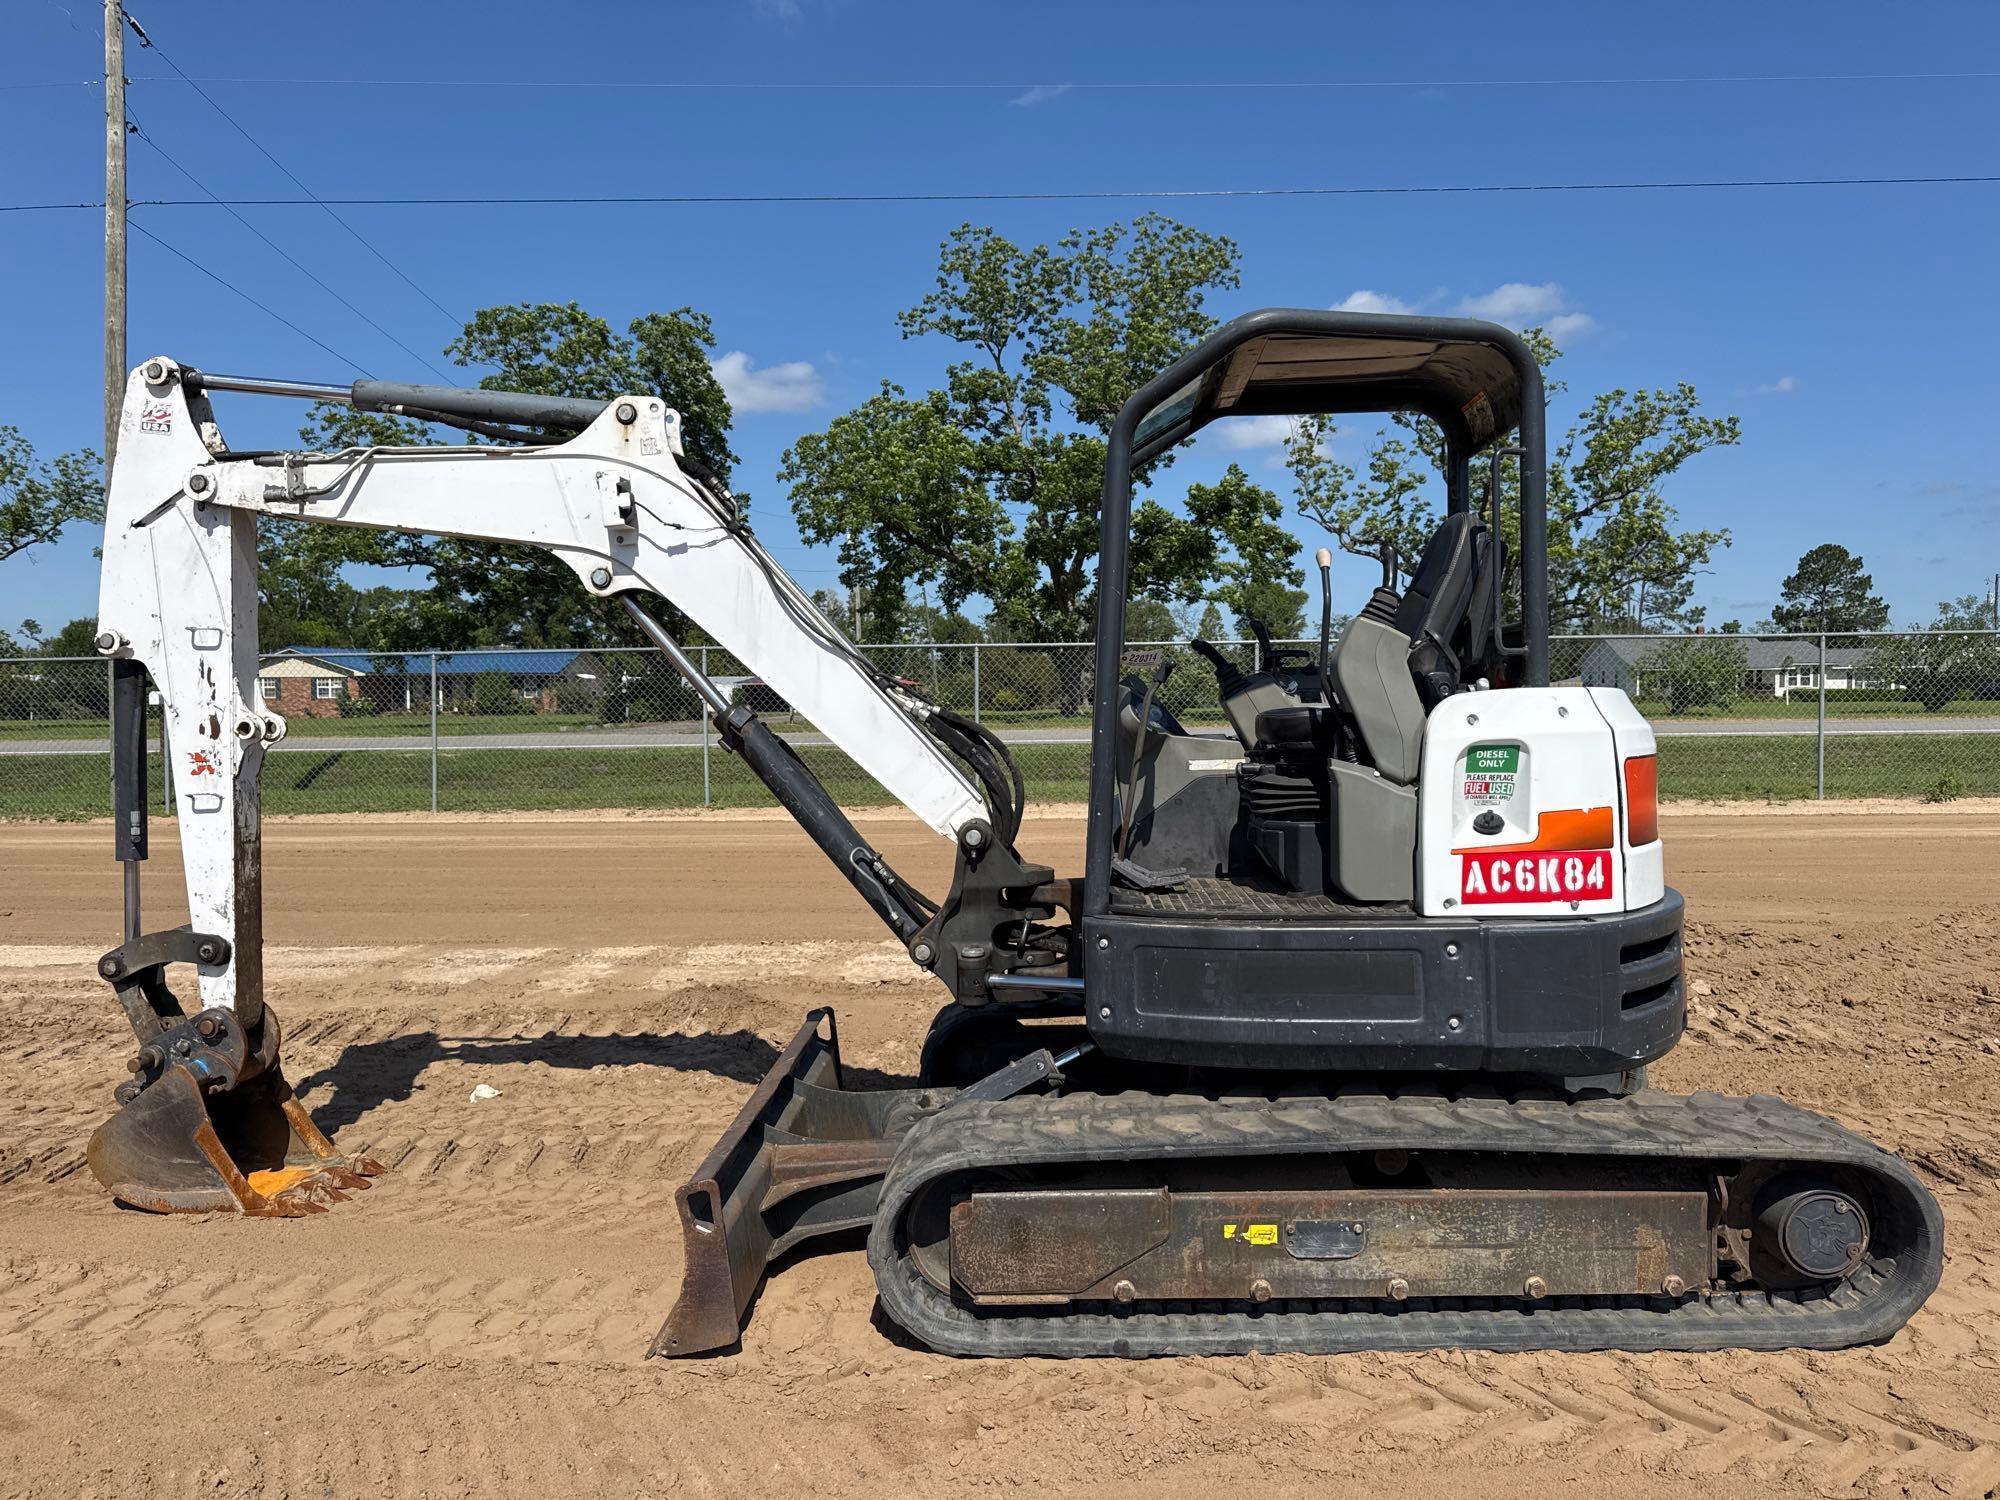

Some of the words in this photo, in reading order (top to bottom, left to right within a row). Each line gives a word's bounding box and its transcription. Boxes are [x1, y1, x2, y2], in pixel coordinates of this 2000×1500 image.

[143, 422, 168, 432] USA
[1476, 750, 1509, 758] DIESEL
[1465, 782, 1487, 794] FUEL
[1489, 782, 1513, 795] USED
[1464, 856, 1605, 894] AC6K84
